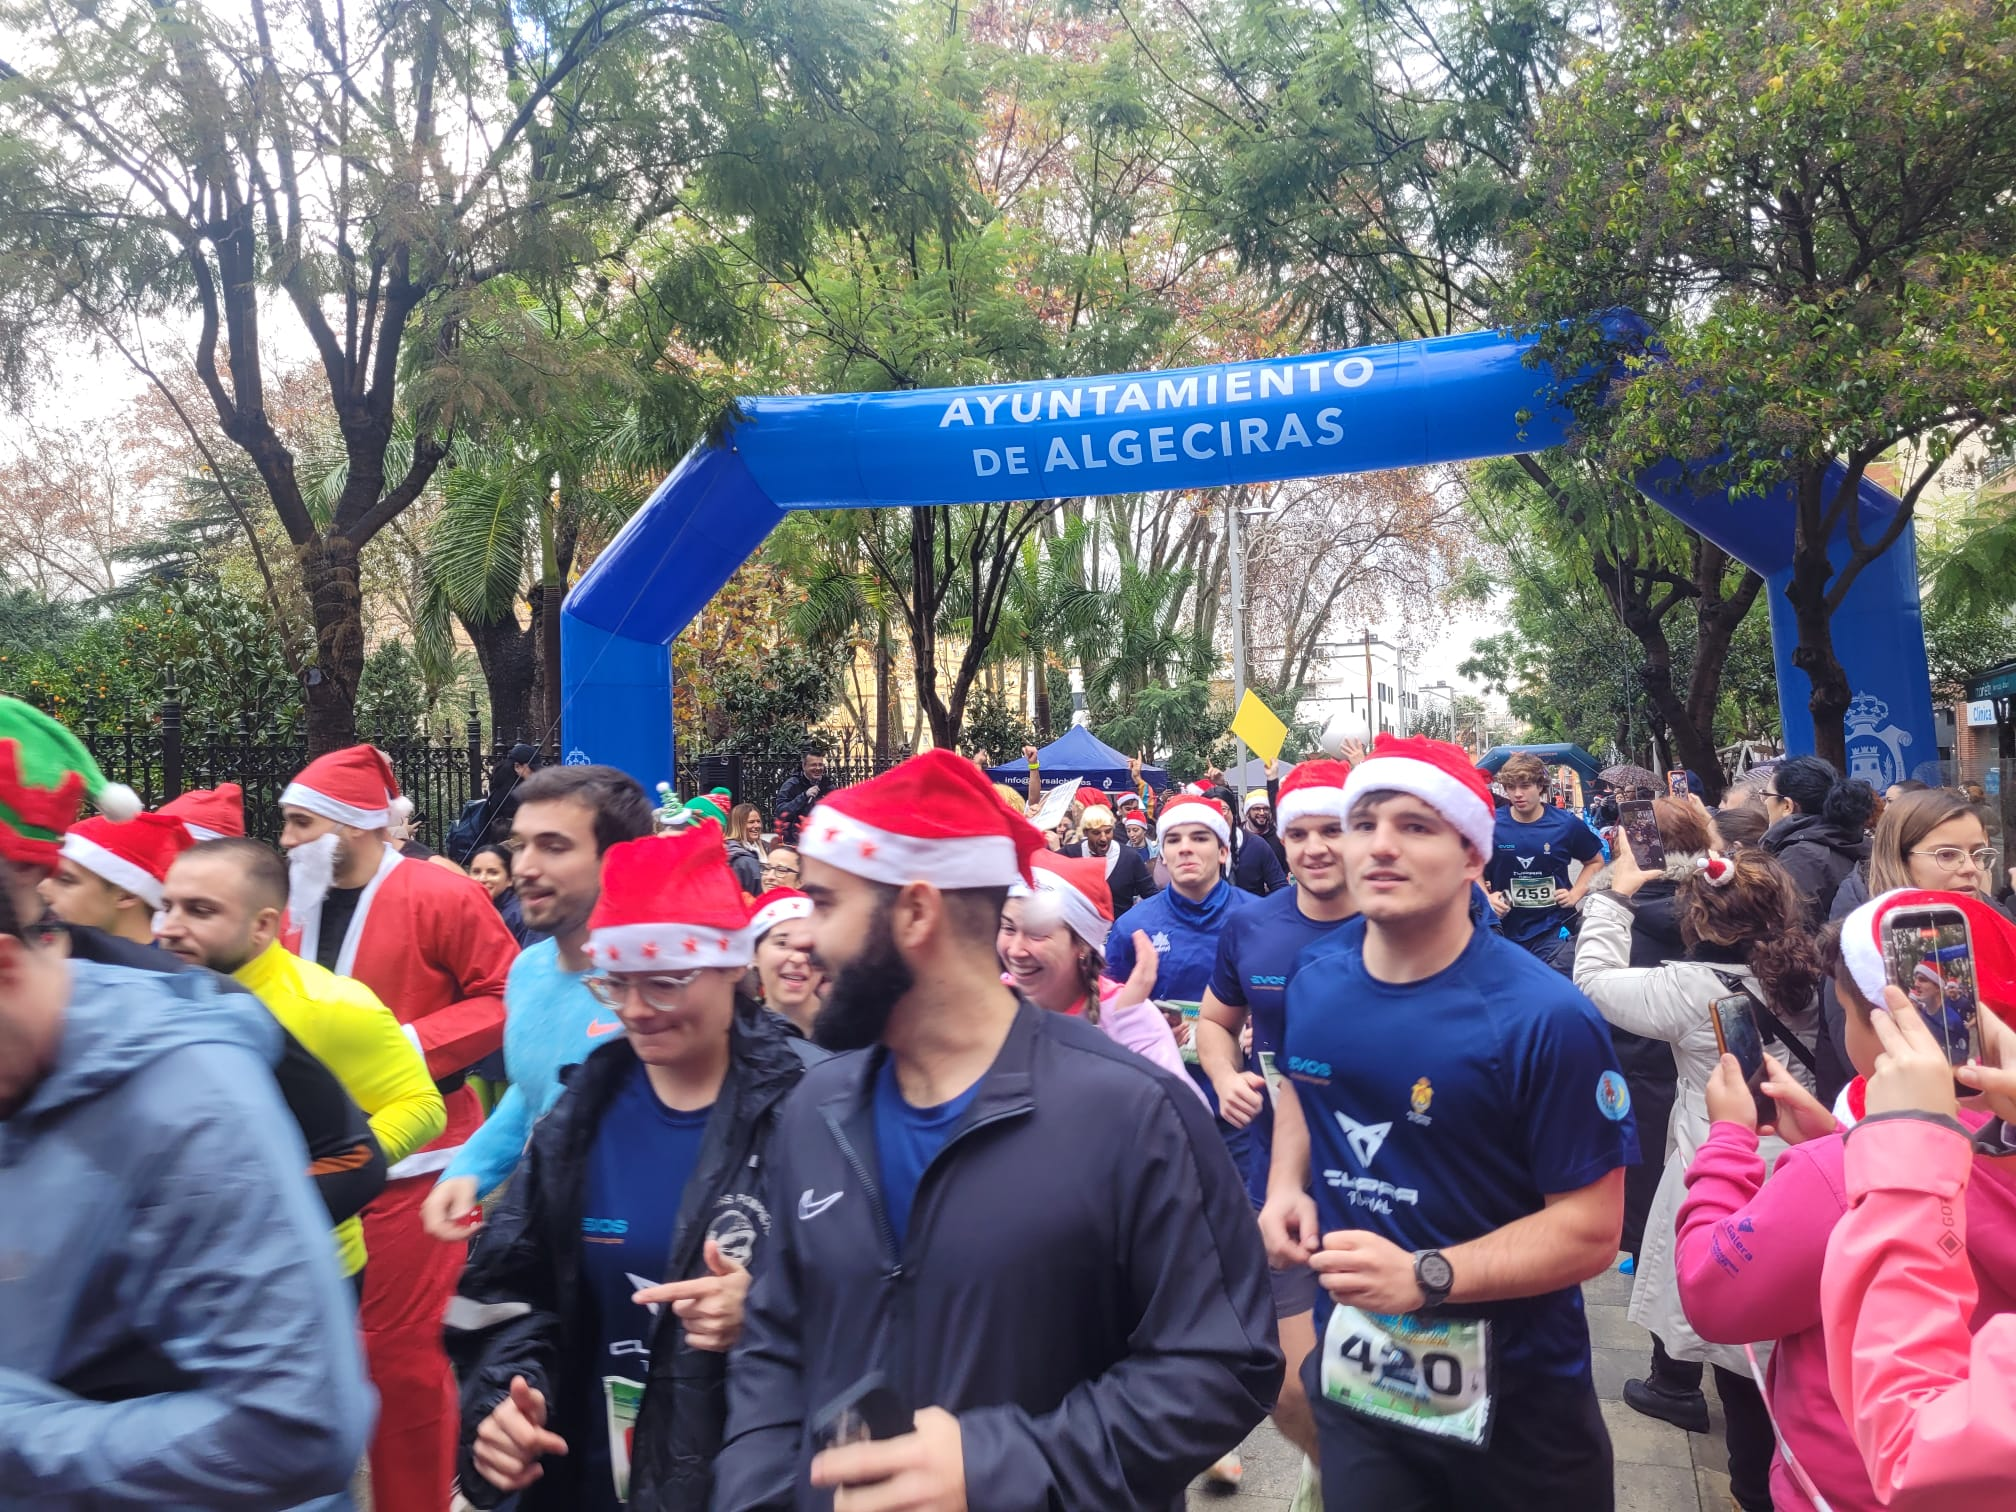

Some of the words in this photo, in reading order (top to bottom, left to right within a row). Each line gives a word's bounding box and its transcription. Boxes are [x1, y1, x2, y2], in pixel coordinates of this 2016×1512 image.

[940, 357, 1374, 427] AYUNTAMIENTO
[972, 446, 1029, 477] DE
[1045, 408, 1344, 472] ALGECIRAS
[1516, 887, 1550, 899] 459
[1341, 1335, 1462, 1396] 420
